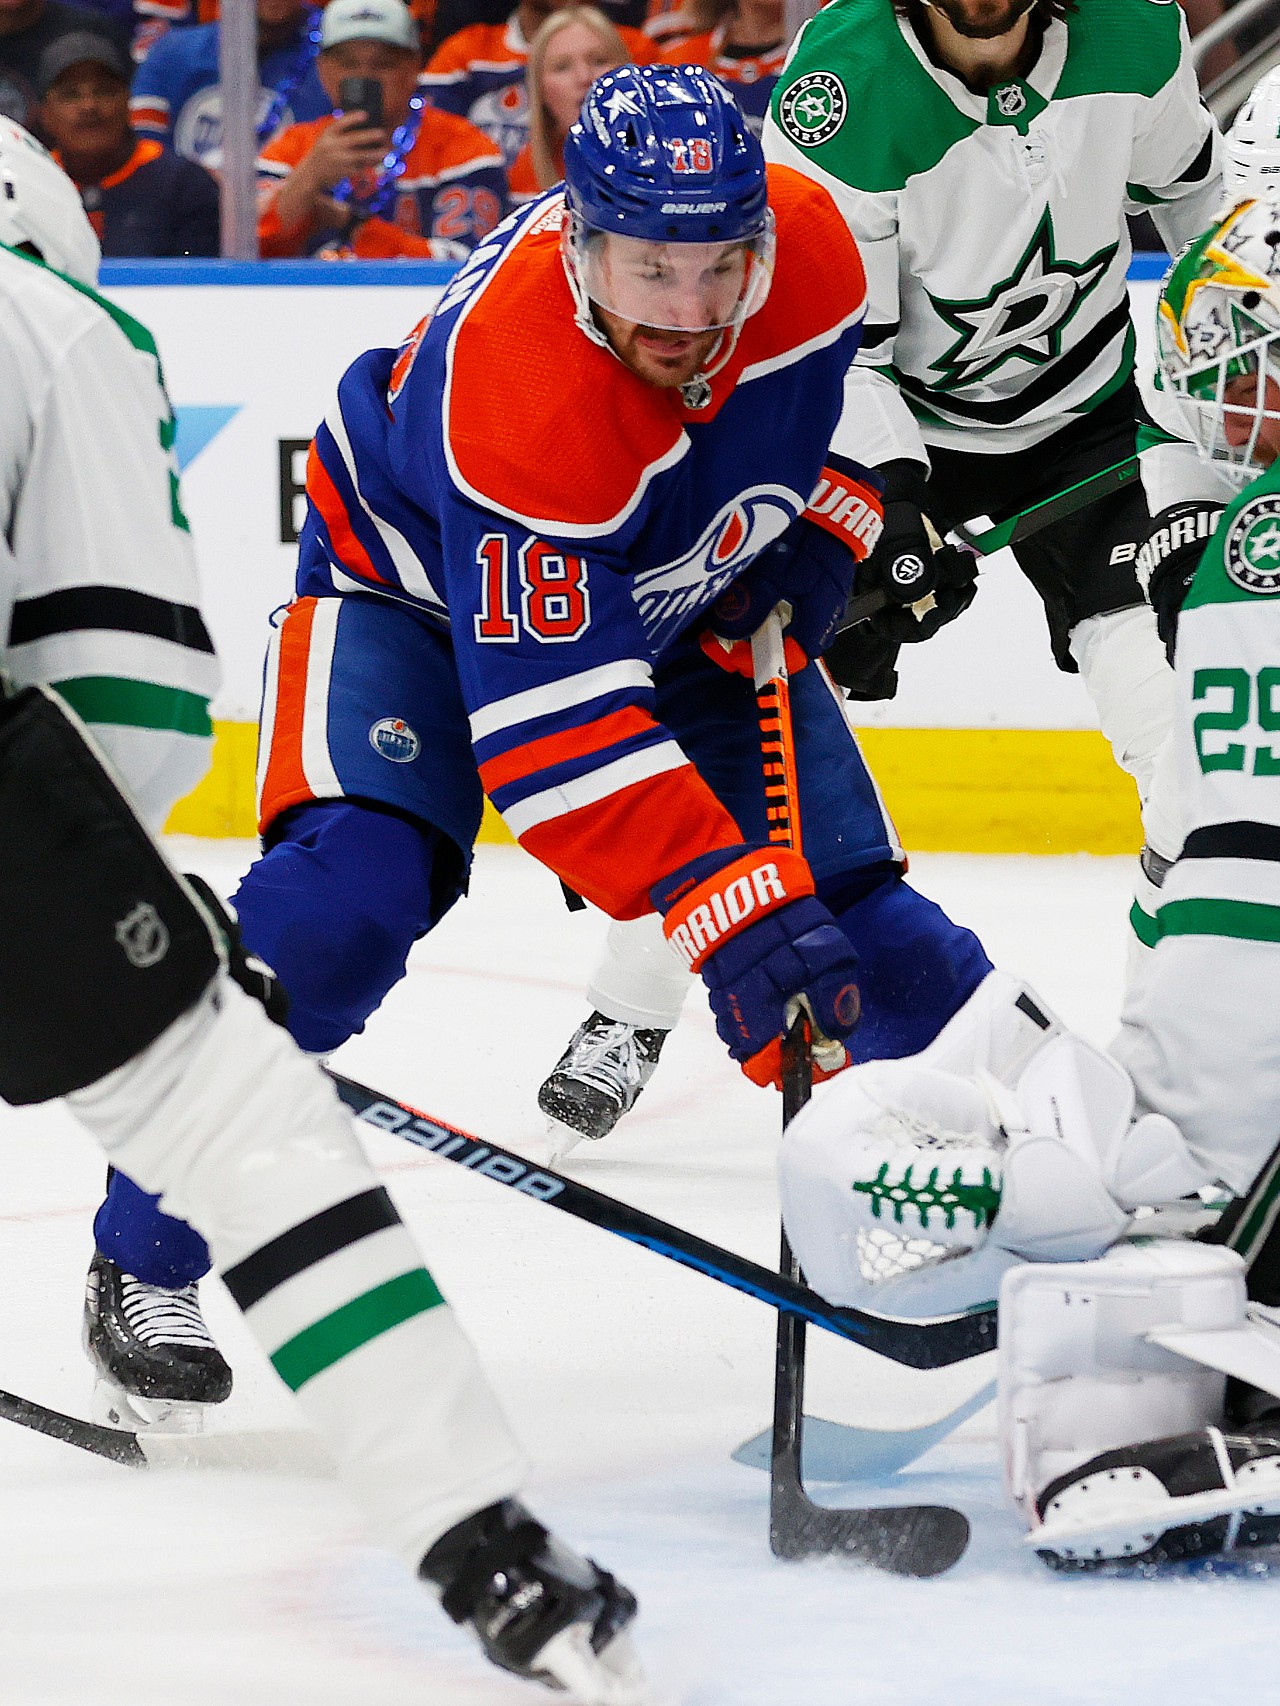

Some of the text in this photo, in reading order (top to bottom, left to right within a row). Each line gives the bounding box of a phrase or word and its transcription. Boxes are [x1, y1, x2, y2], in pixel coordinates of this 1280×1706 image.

[799, 75, 842, 122] DALLAS
[669, 137, 714, 175] 18
[661, 201, 727, 215] BAUER
[473, 532, 592, 644] 18
